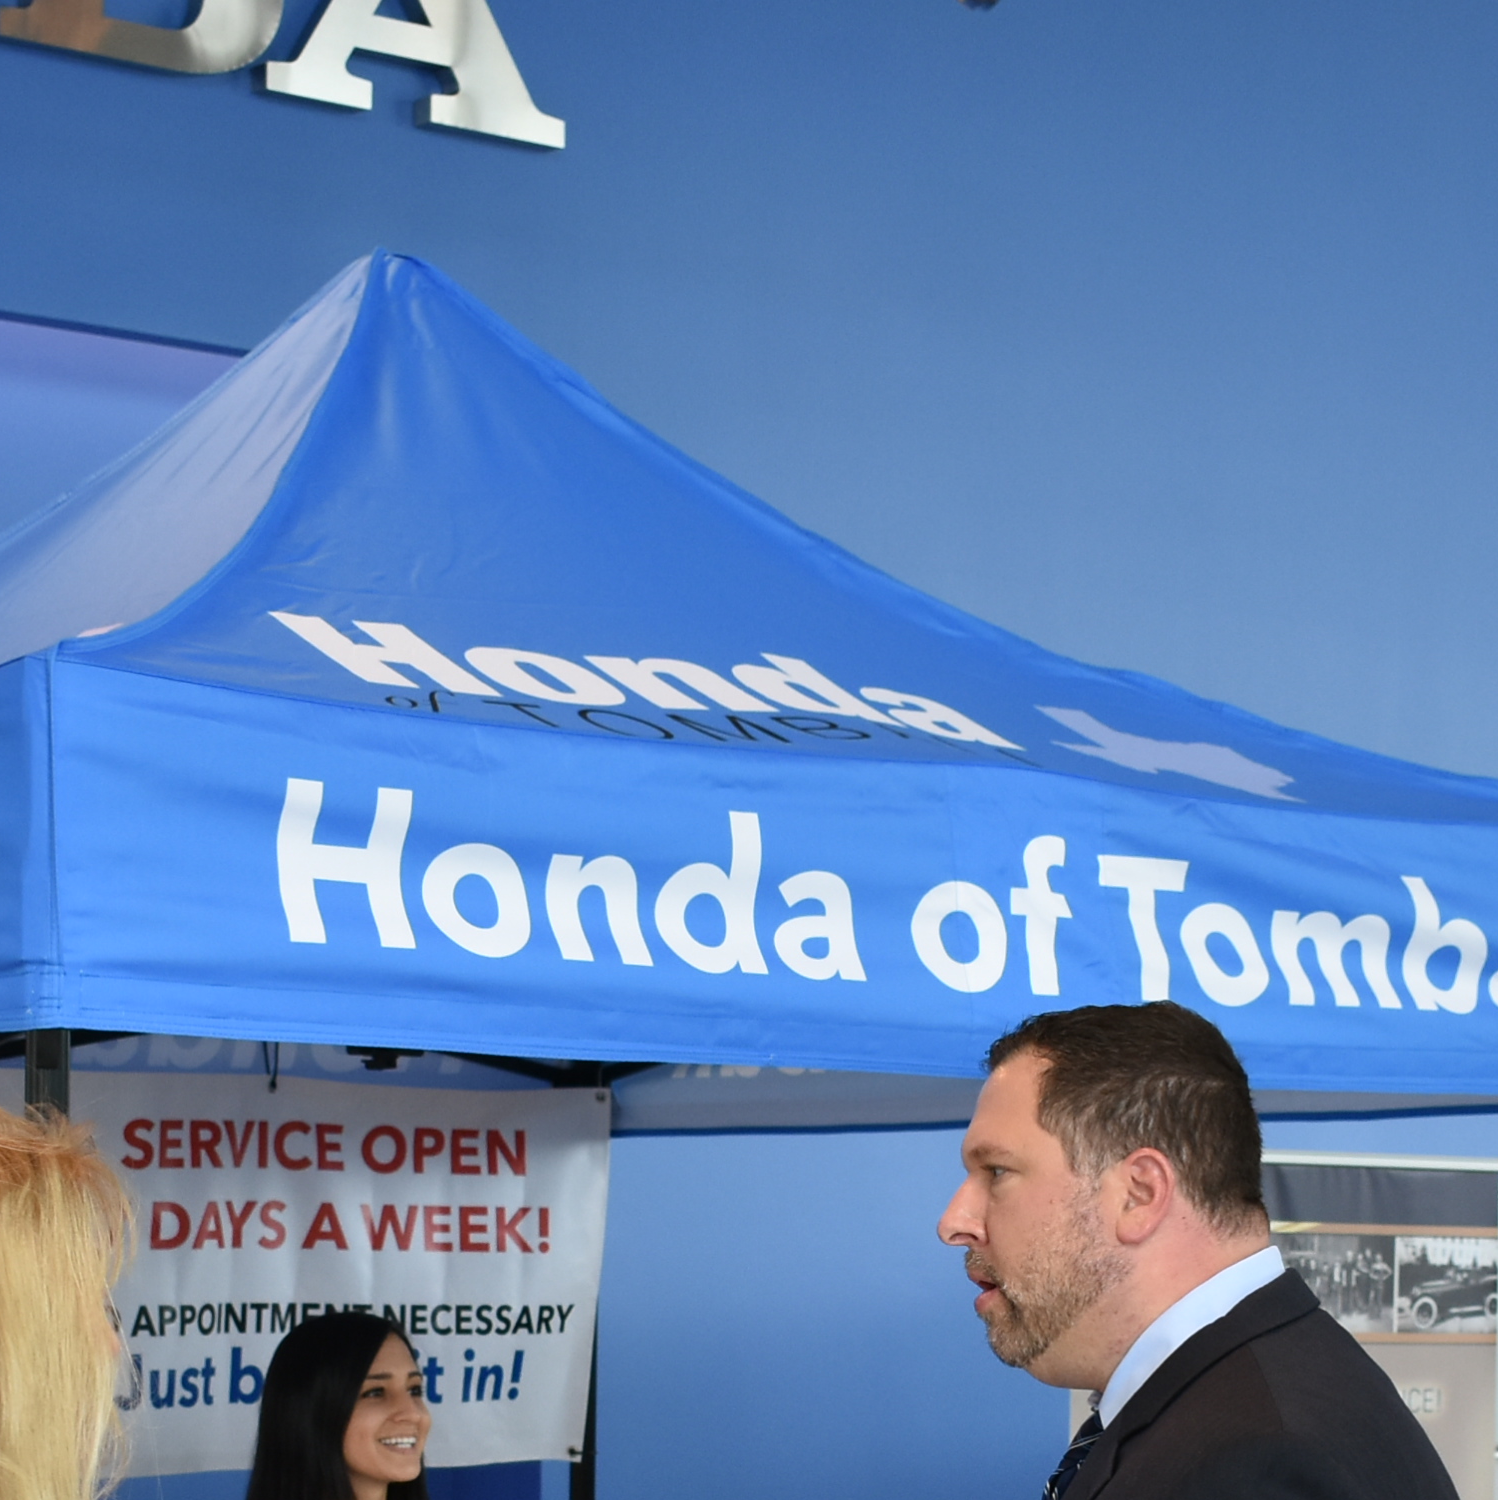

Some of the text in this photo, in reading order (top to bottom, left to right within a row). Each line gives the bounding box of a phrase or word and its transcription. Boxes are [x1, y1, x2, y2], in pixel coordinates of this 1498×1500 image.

[268, 610, 1027, 751] Honda
[276, 777, 868, 983] Honda
[911, 834, 1071, 998] of
[121, 1119, 527, 1176] SERVICE OPEN
[149, 1200, 551, 1254] DAYS A WEEK!
[382, 1303, 574, 1337] NECESSARY
[461, 1348, 525, 1402] in!
